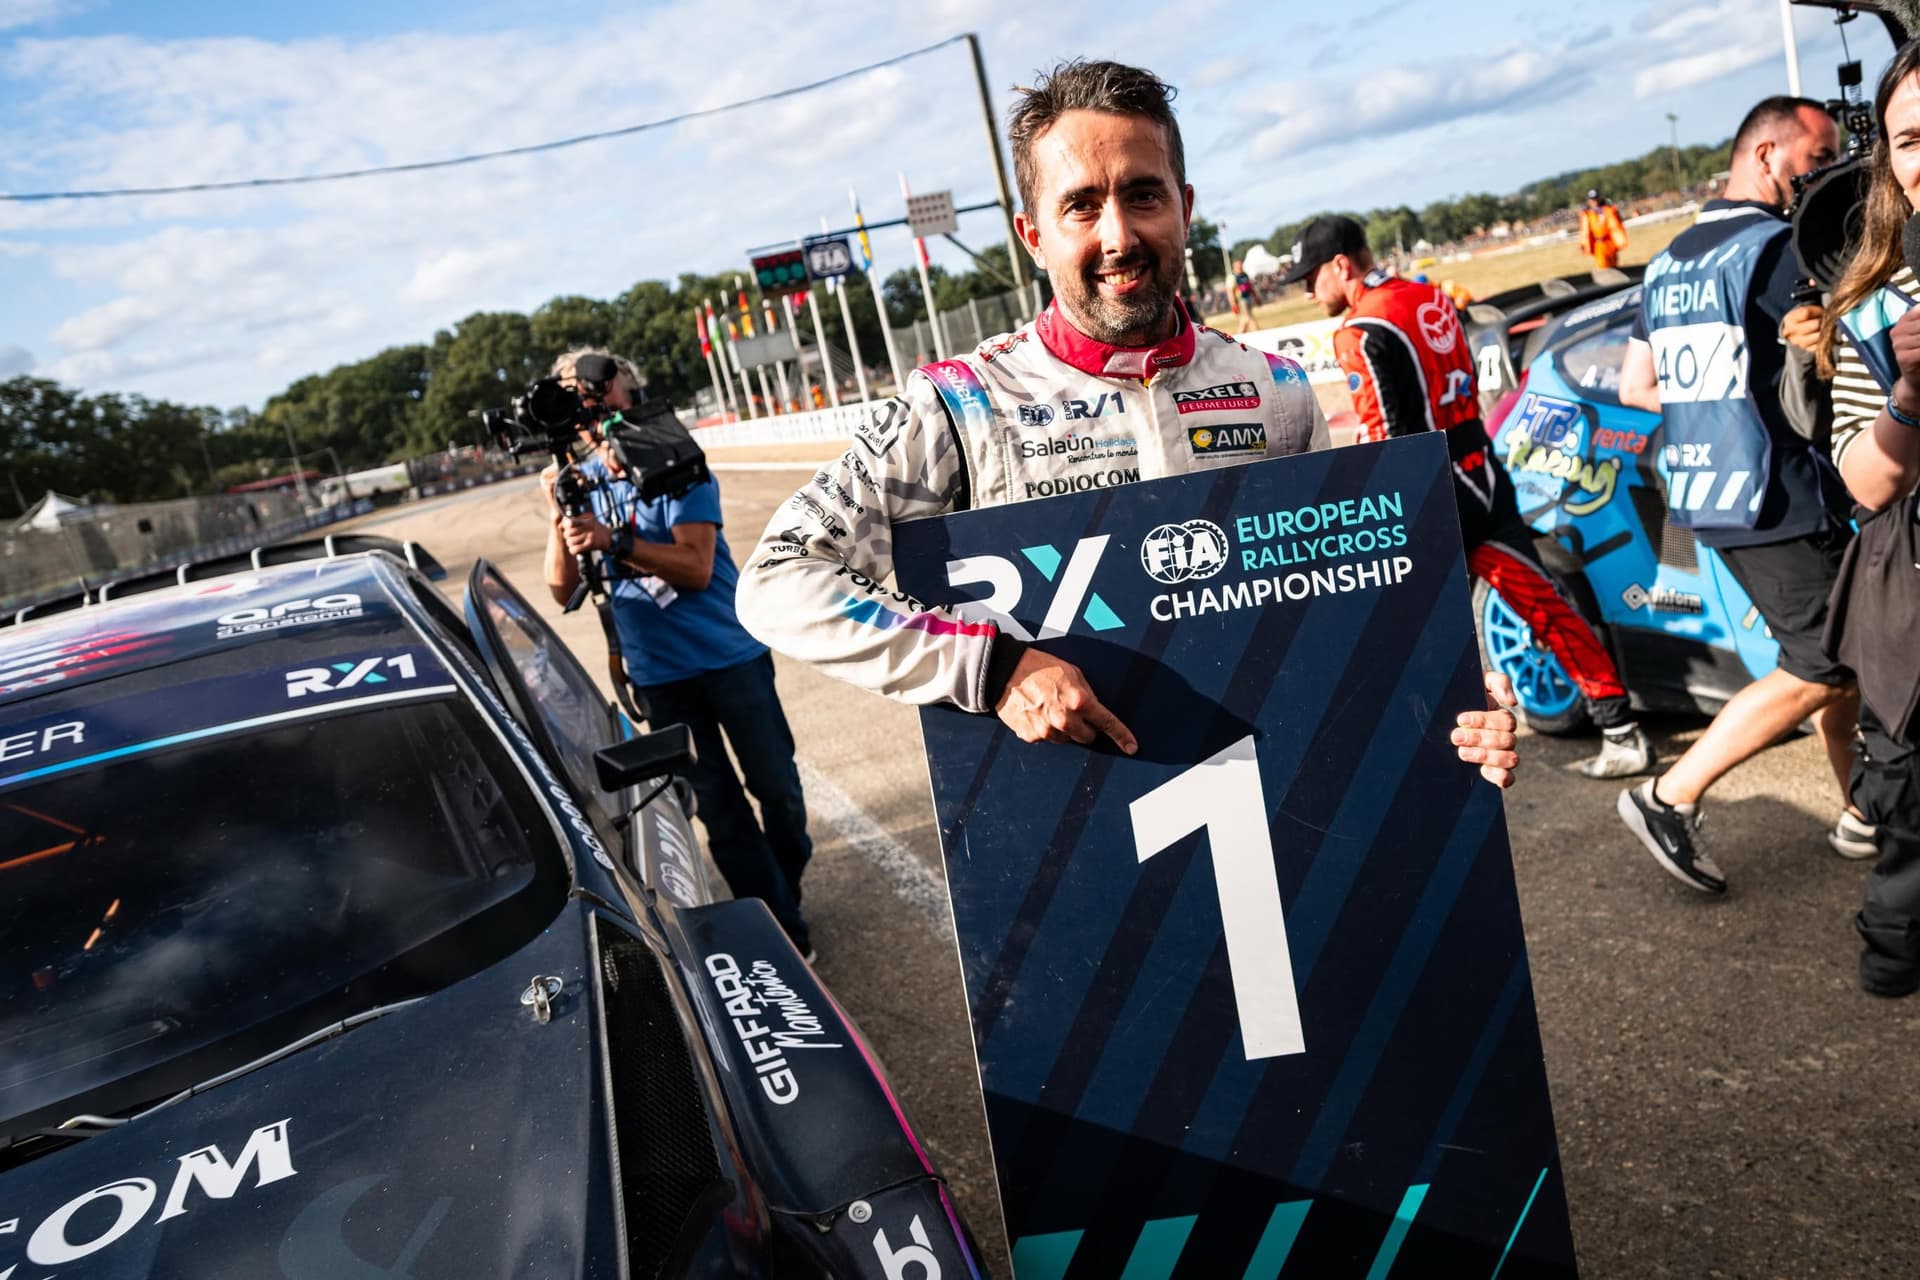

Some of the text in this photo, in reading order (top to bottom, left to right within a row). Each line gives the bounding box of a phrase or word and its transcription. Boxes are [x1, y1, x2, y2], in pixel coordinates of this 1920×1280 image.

[809, 248, 849, 276] FIA
[1651, 279, 1719, 319] MEDIA
[1659, 344, 1698, 390] 40
[1070, 391, 1125, 420] RX1
[1181, 399, 1258, 412] FERMETURES
[1021, 433, 1137, 459] Salaün Holidays
[1115, 447, 1139, 457] monde
[1216, 427, 1263, 448] AMY
[1592, 427, 1649, 455] renta
[1682, 442, 1712, 467] RX
[1025, 467, 1142, 499] PODIOCOM
[1147, 491, 1404, 574] FIA EUROPEAN
[769, 545, 809, 557] TURBO
[945, 533, 1126, 641] RX
[1240, 523, 1408, 572] RALLYCROSS
[1149, 555, 1414, 622] CHAMPIONSHIP
[286, 653, 417, 698] RX1
[1128, 734, 1306, 1061] 1
[704, 952, 800, 1106] GIFFARD
[0, 1116, 299, 1266] OM
